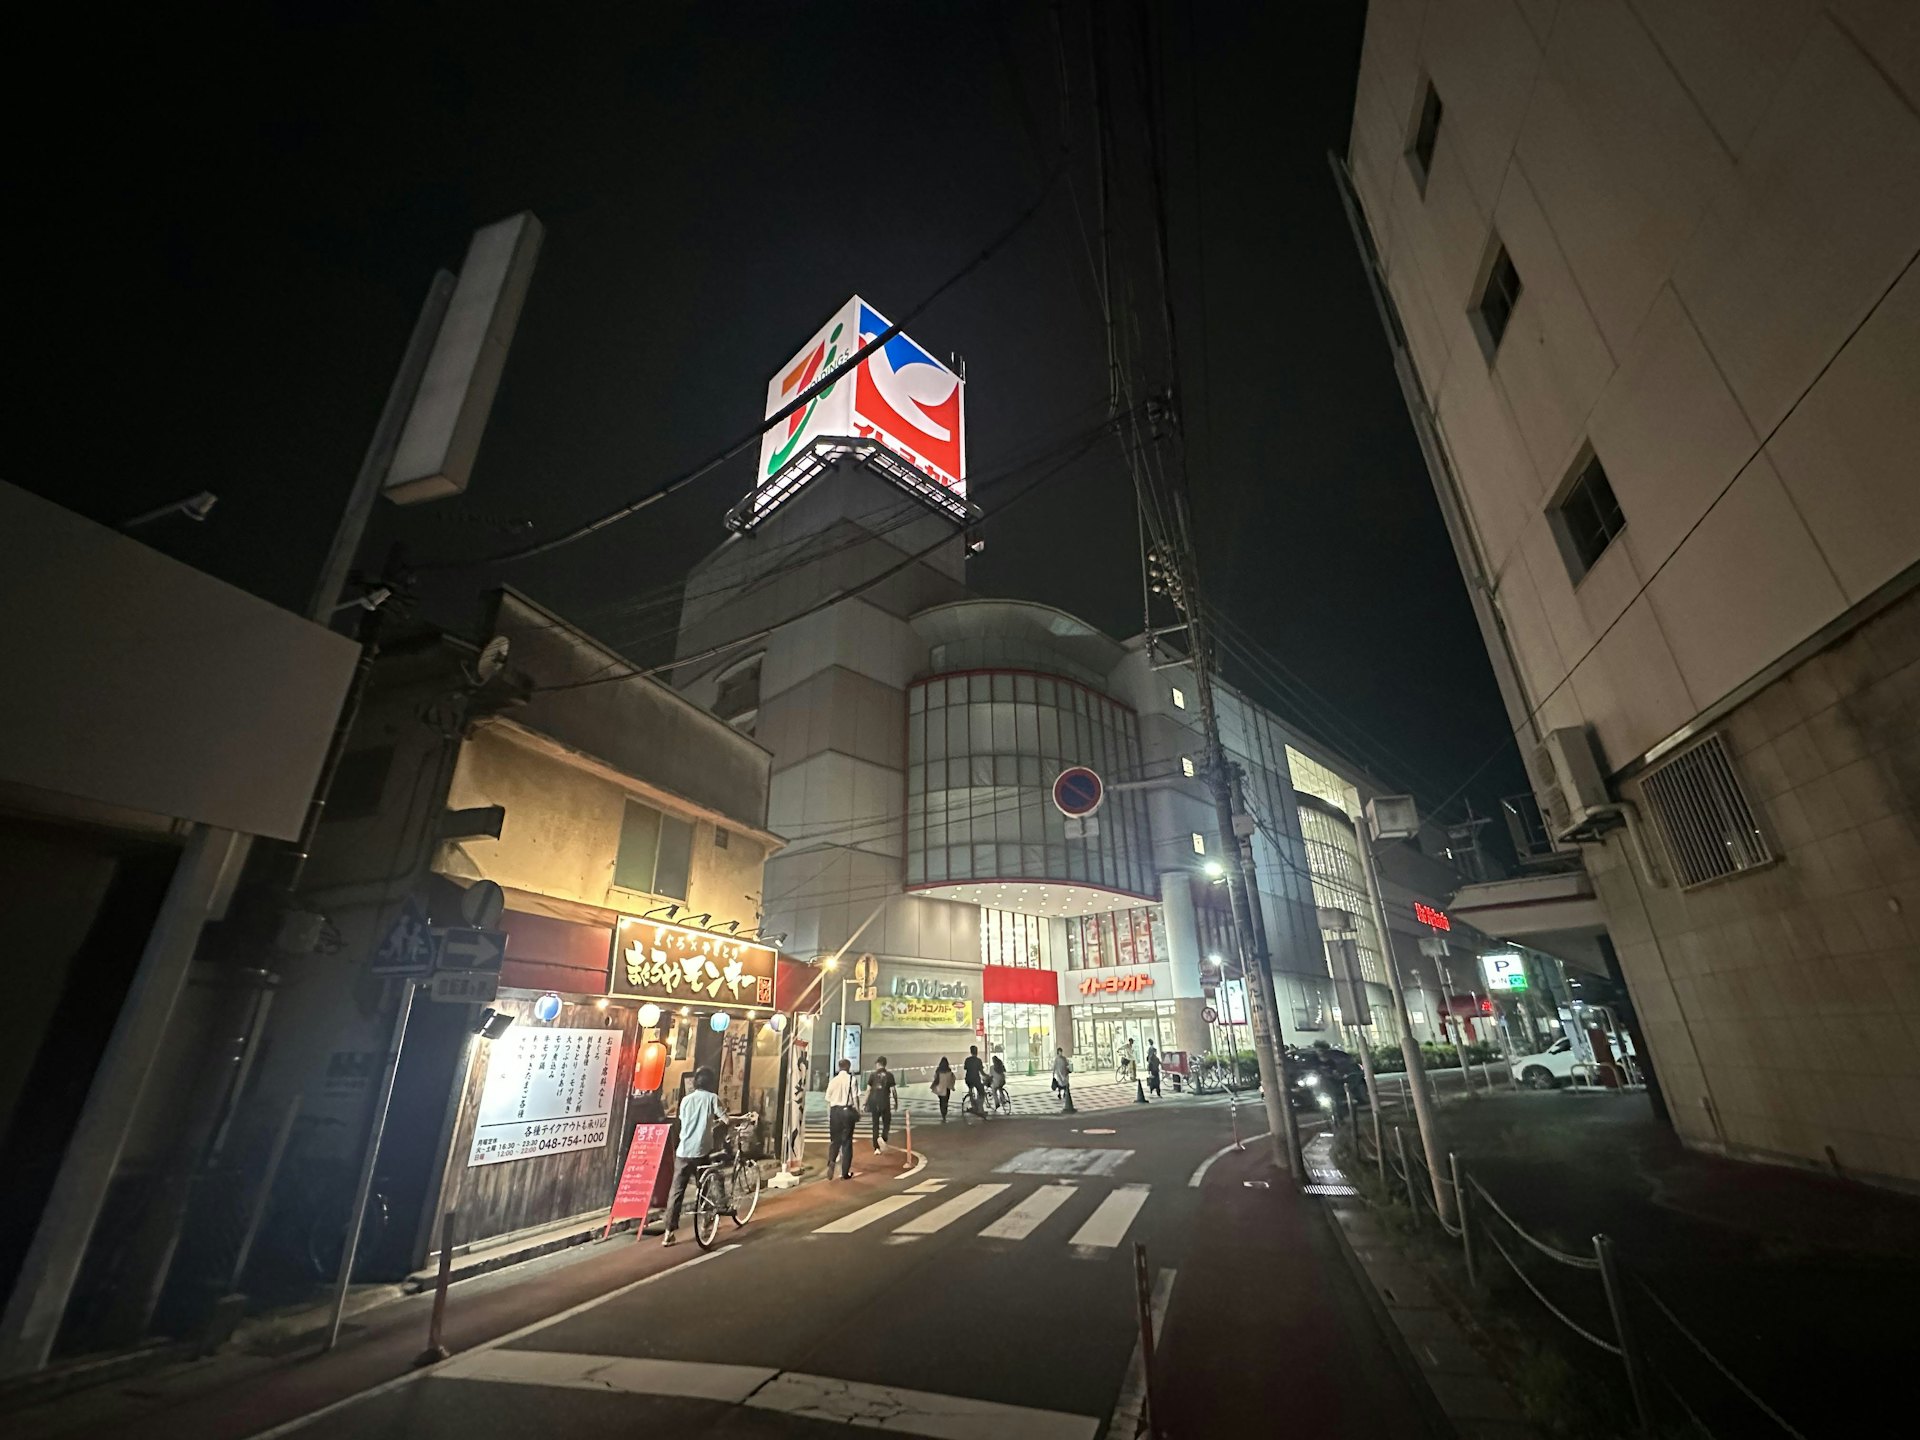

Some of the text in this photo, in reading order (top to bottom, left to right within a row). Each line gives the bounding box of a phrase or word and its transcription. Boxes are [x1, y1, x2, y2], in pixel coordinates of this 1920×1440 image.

[1495, 960, 1510, 973] P
[1079, 974, 1154, 995] イトーヨーカドー
[499, 1142, 515, 1150] 16:30
[522, 1139, 538, 1147] 23:30
[538, 1132, 604, 1151] 048-754-1000
